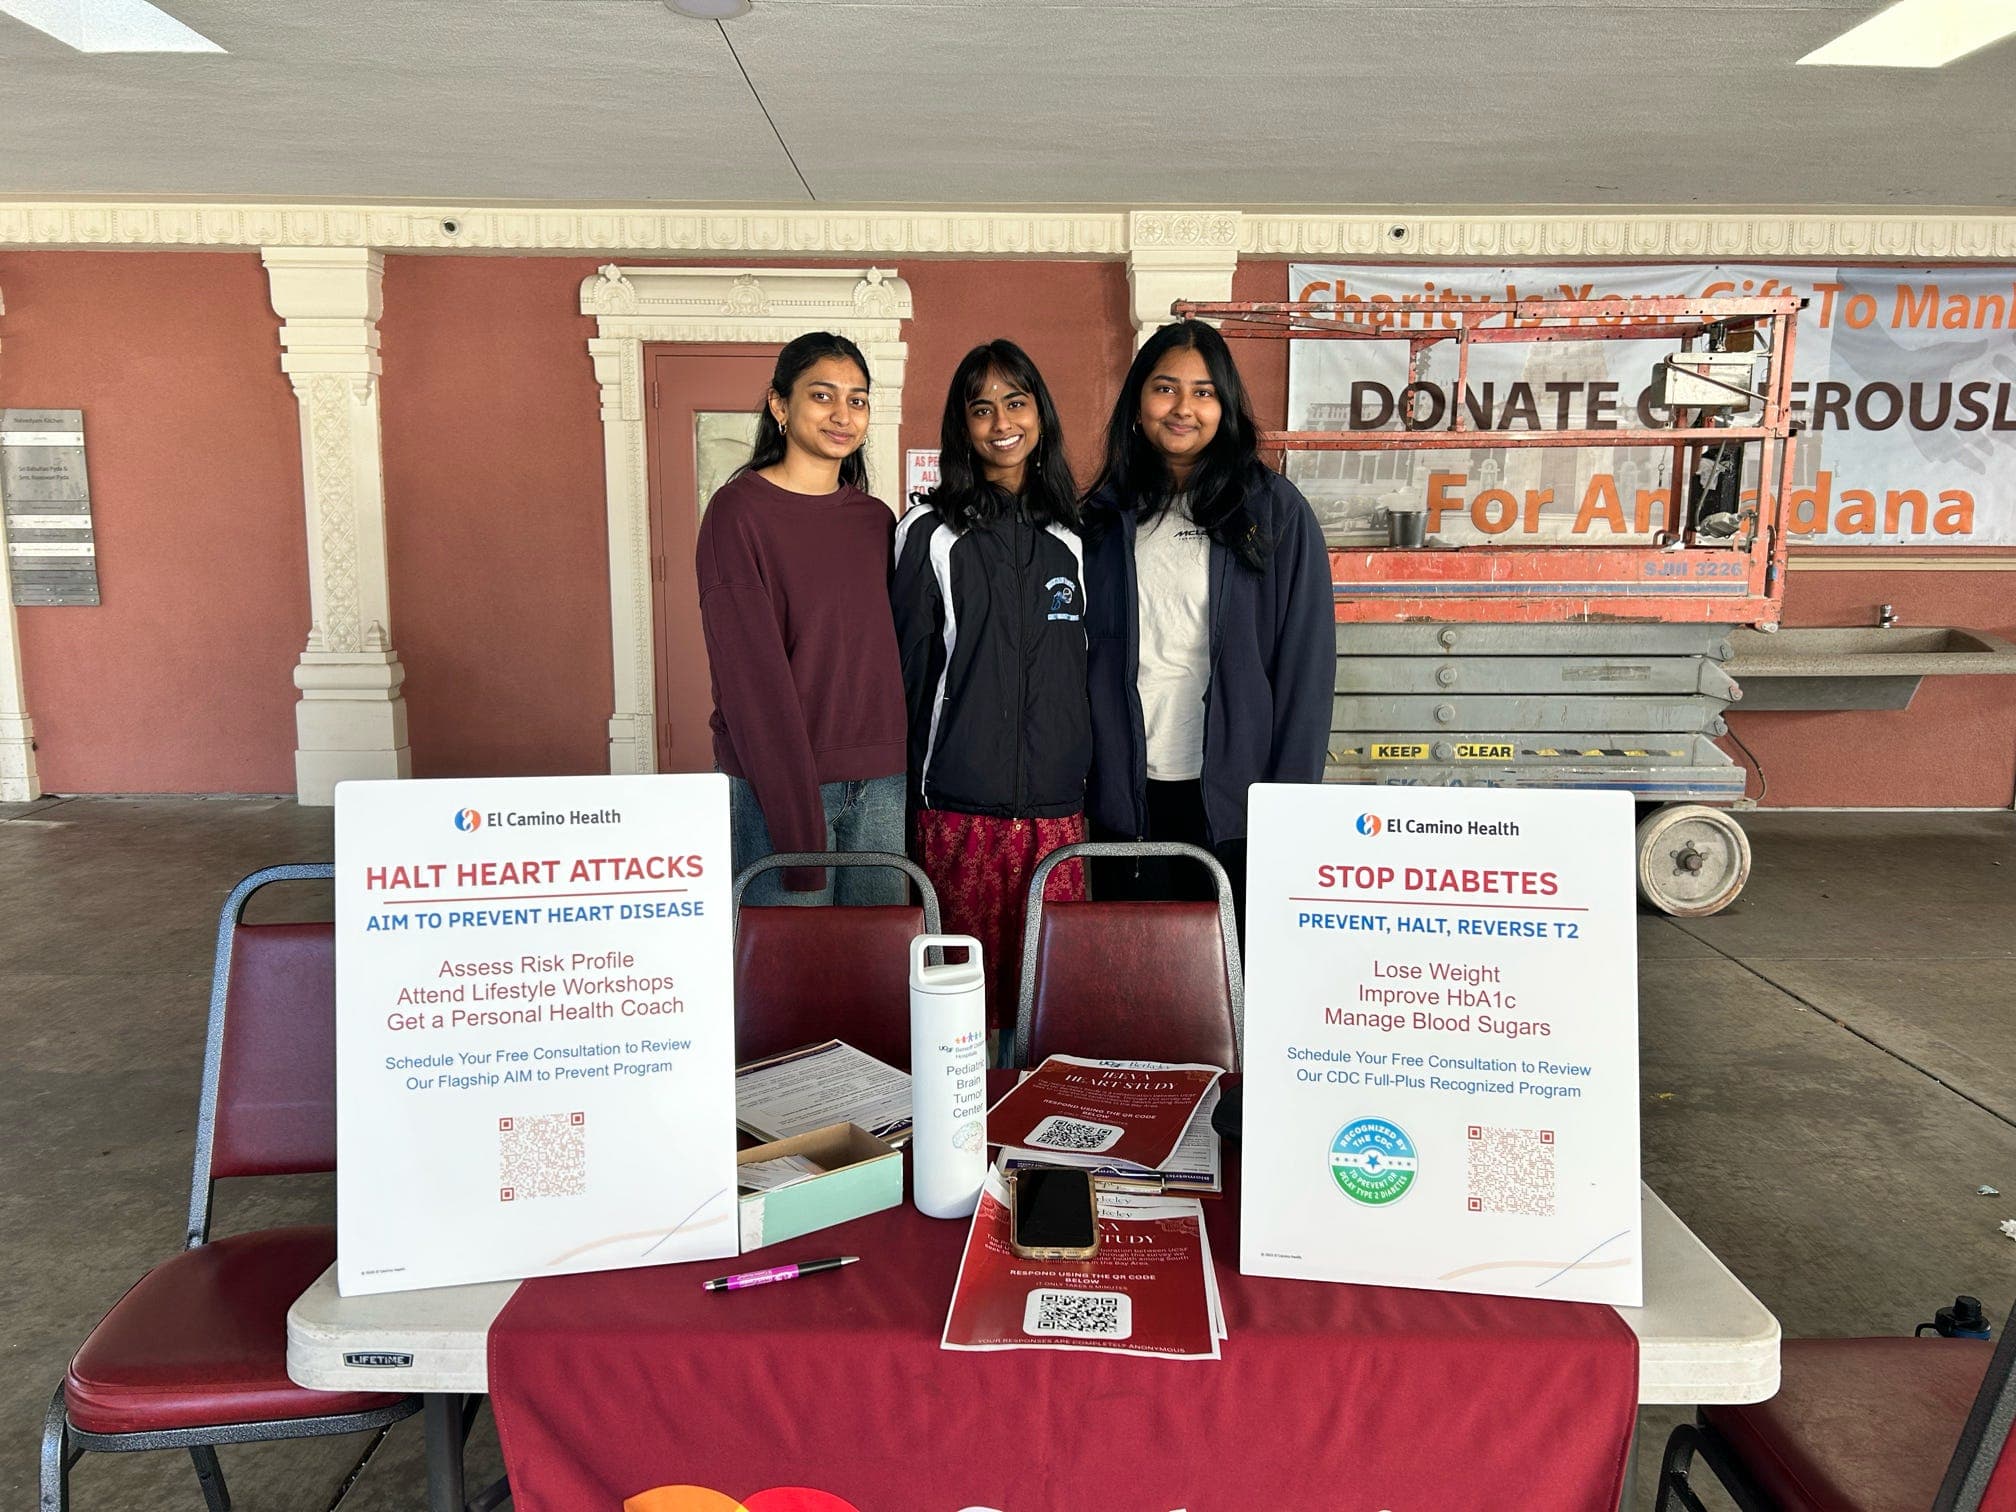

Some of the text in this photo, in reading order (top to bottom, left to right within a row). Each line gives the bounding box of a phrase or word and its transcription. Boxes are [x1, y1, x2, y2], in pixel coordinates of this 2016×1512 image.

[1701, 279, 1793, 328] Gif
[1813, 283, 1877, 330] To
[1891, 282, 2016, 330] Man
[1349, 380, 2016, 432] DONATE GEROUSL
[915, 456, 926, 467] AS
[922, 471, 938, 482] ALL
[1427, 471, 1976, 536] For Anadana
[1695, 562, 1743, 577] 3226
[1378, 745, 1511, 758] KEEP CLEAR
[488, 809, 620, 827] El Camino Health
[1388, 819, 1519, 836] El Camino Health
[367, 855, 703, 890] HALT HEART ATTACKS
[1319, 865, 1558, 895] STOP DIABETES
[367, 901, 704, 931] AIM TO PREVENT HEART DISEASE
[1299, 913, 1579, 938] PREVENT, HALT, REVERSE T2
[439, 952, 634, 977] Assess Risk Profile
[1375, 960, 1500, 986] Lose Weight
[397, 975, 673, 1005] Attend Lifestyle Workshops
[1360, 984, 1516, 1009] Improve HbA1c
[387, 997, 683, 1031] Get a Personal Health Coach
[1326, 1008, 1550, 1039] Manage Blood Sugars
[386, 1039, 691, 1069] Schedule Your Free Consultation to Review
[1288, 1047, 1591, 1076] Schedule Your Free Consultation to Review
[407, 1062, 672, 1090] Our Flagship AIM to Prevent Program
[956, 1076, 981, 1090] Brain
[1065, 1074, 1177, 1090] HEART STUDY
[1297, 1069, 1580, 1099] Our CDC Full-Plus Recognized Program
[953, 1103, 983, 1118] Center
[1340, 1124, 1396, 1147] RECOGNIZED
[1353, 1135, 1393, 1149] THE CDC
[1356, 1187, 1373, 1199] TYPE
[1359, 1177, 1388, 1189] PREVENT
[1072, 1340, 1127, 1348] COMPLETELY
[1129, 1343, 1185, 1353] ANONYMOUS
[352, 1355, 404, 1364] LIFETIME
